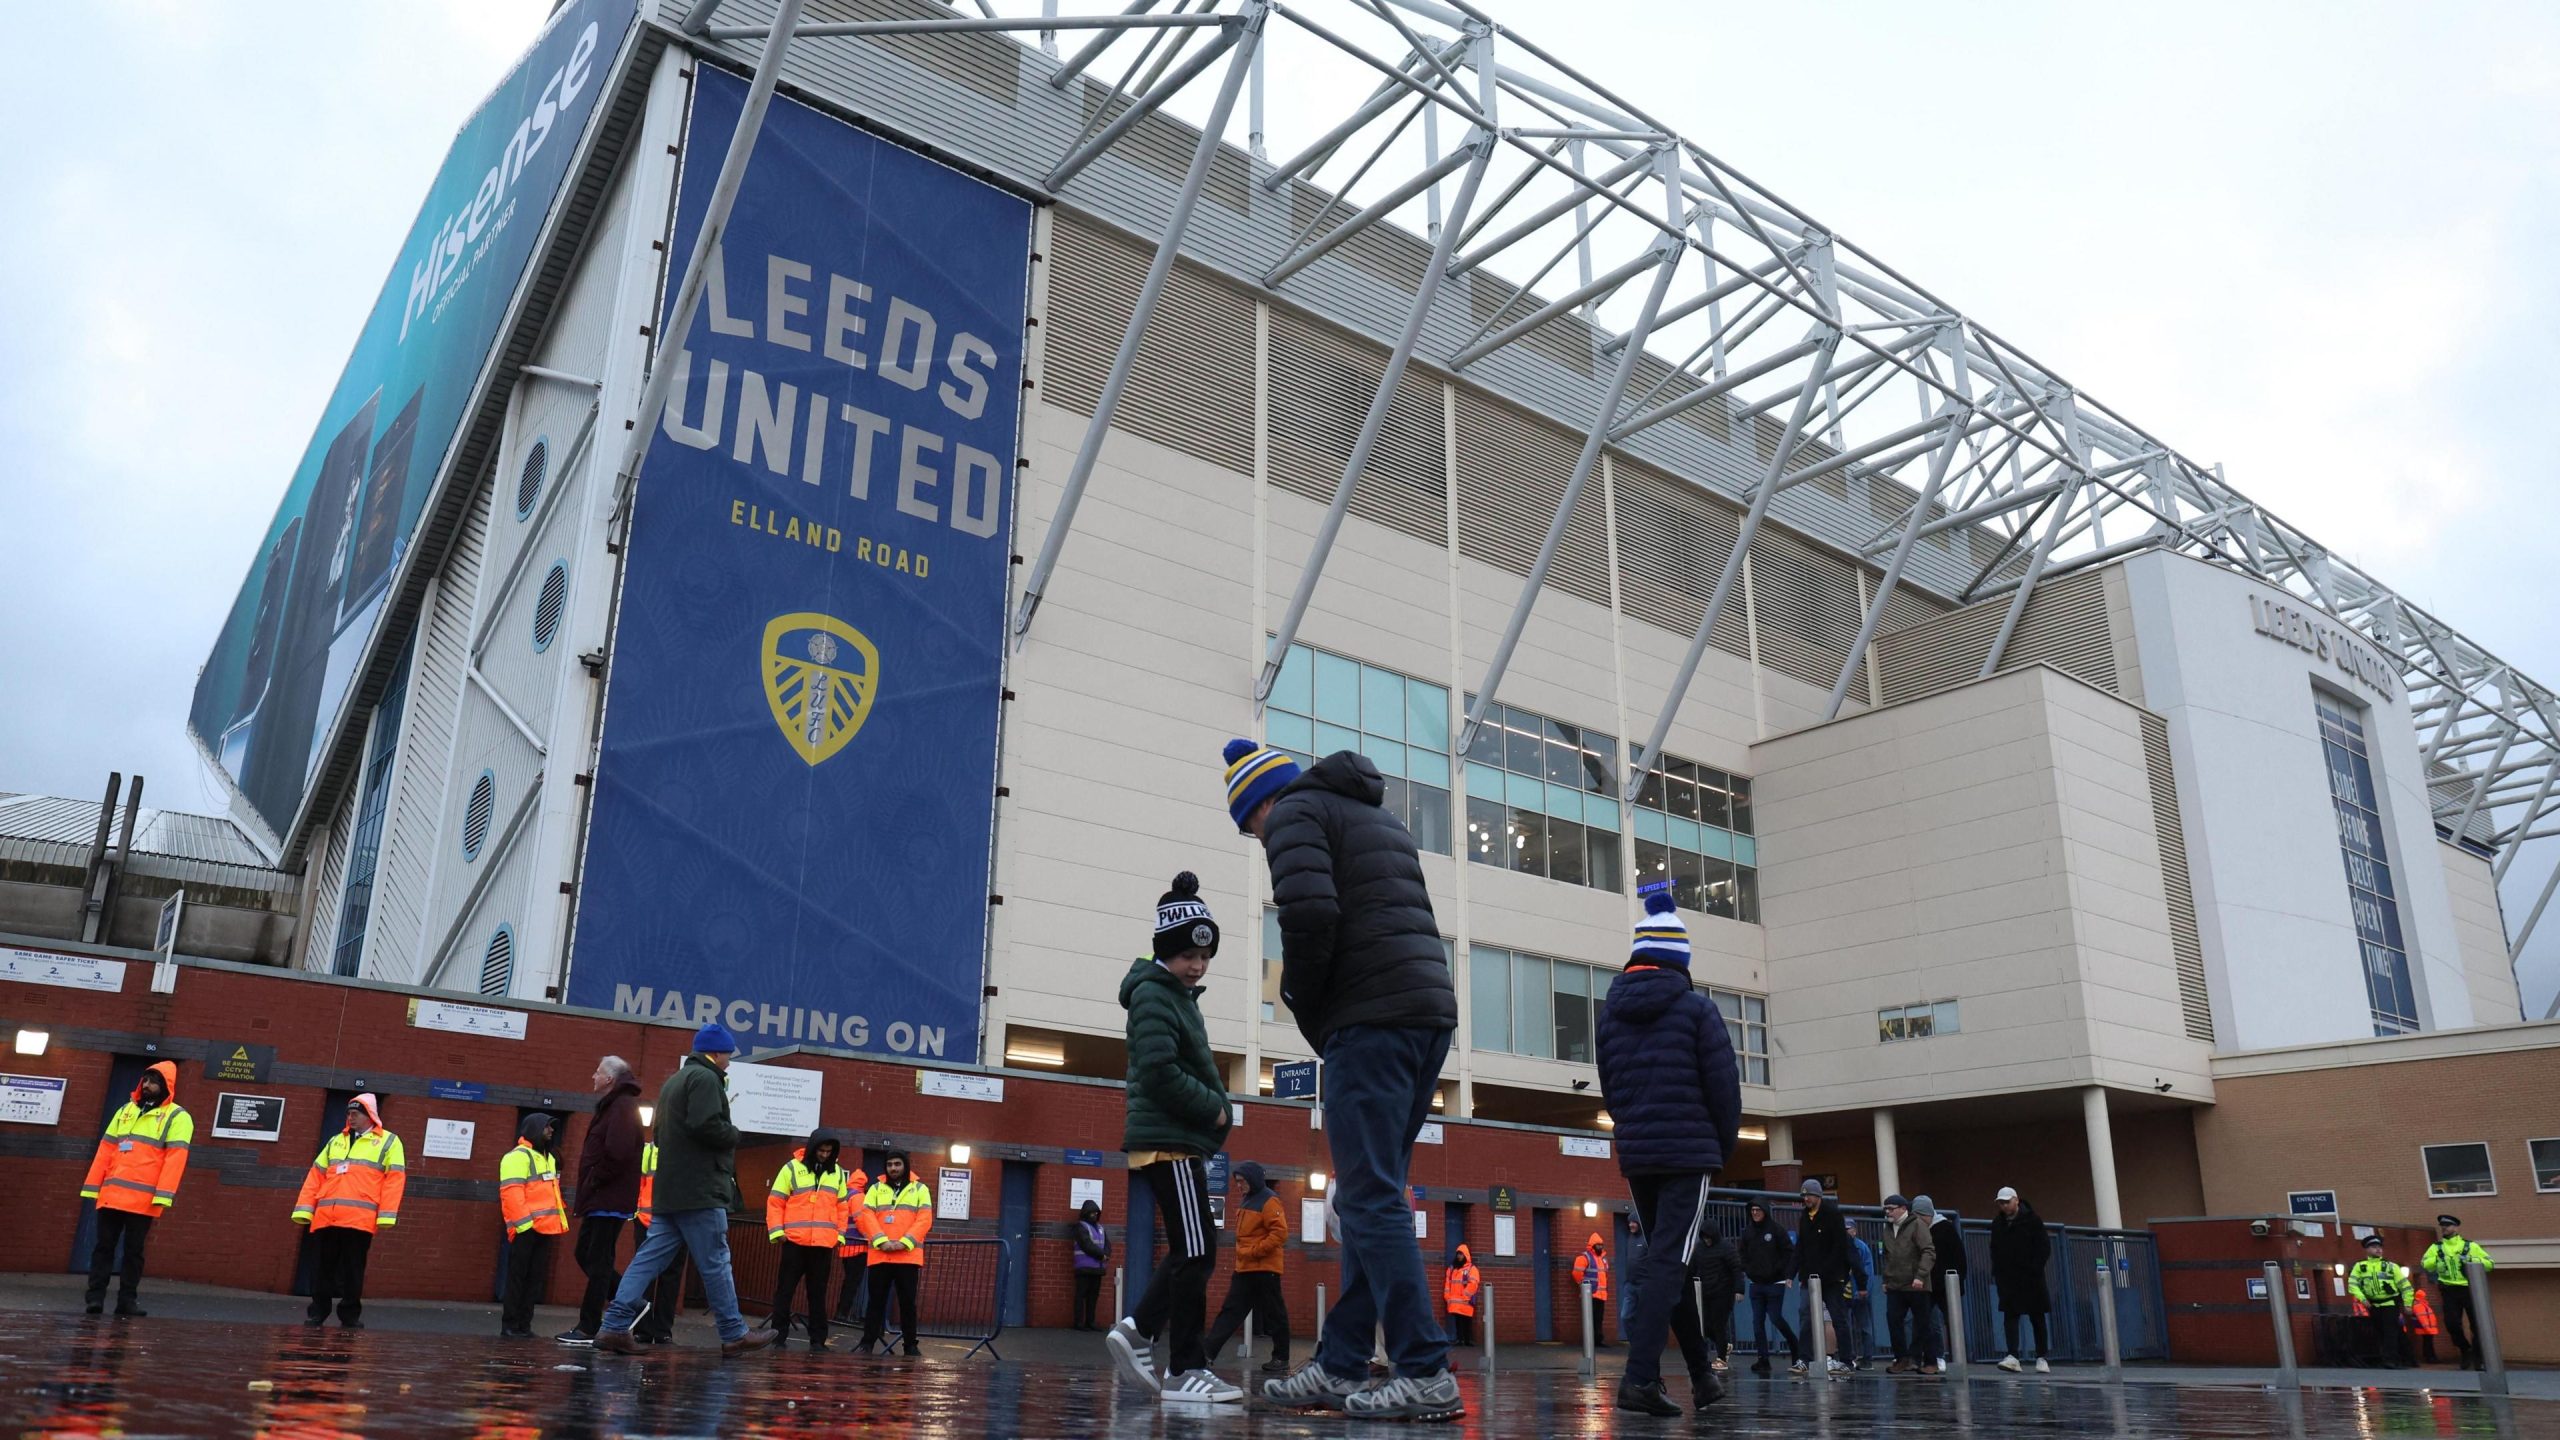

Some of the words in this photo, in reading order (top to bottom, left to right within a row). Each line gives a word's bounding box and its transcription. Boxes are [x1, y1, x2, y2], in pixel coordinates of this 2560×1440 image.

[398, 21, 598, 346] Hisense
[432, 260, 471, 324] OFFICIAL
[472, 197, 516, 271] PARTNER
[705, 243, 998, 420] LEEDS
[662, 349, 1002, 539] UNITED
[731, 499, 841, 552] ELLAND
[857, 537, 929, 578] ROAD
[613, 983, 870, 1047] MARCHING
[885, 1021, 946, 1056] ON
[233, 1061, 256, 1069] AWARE
[218, 1071, 255, 1080] OPERATION
[1281, 1067, 1310, 1079] ENTRANCE
[355, 1079, 365, 1087] 85
[1291, 1078, 1301, 1091] 12
[2296, 1195, 2328, 1203] ENTRANCE
[2308, 1202, 2318, 1211] 11
